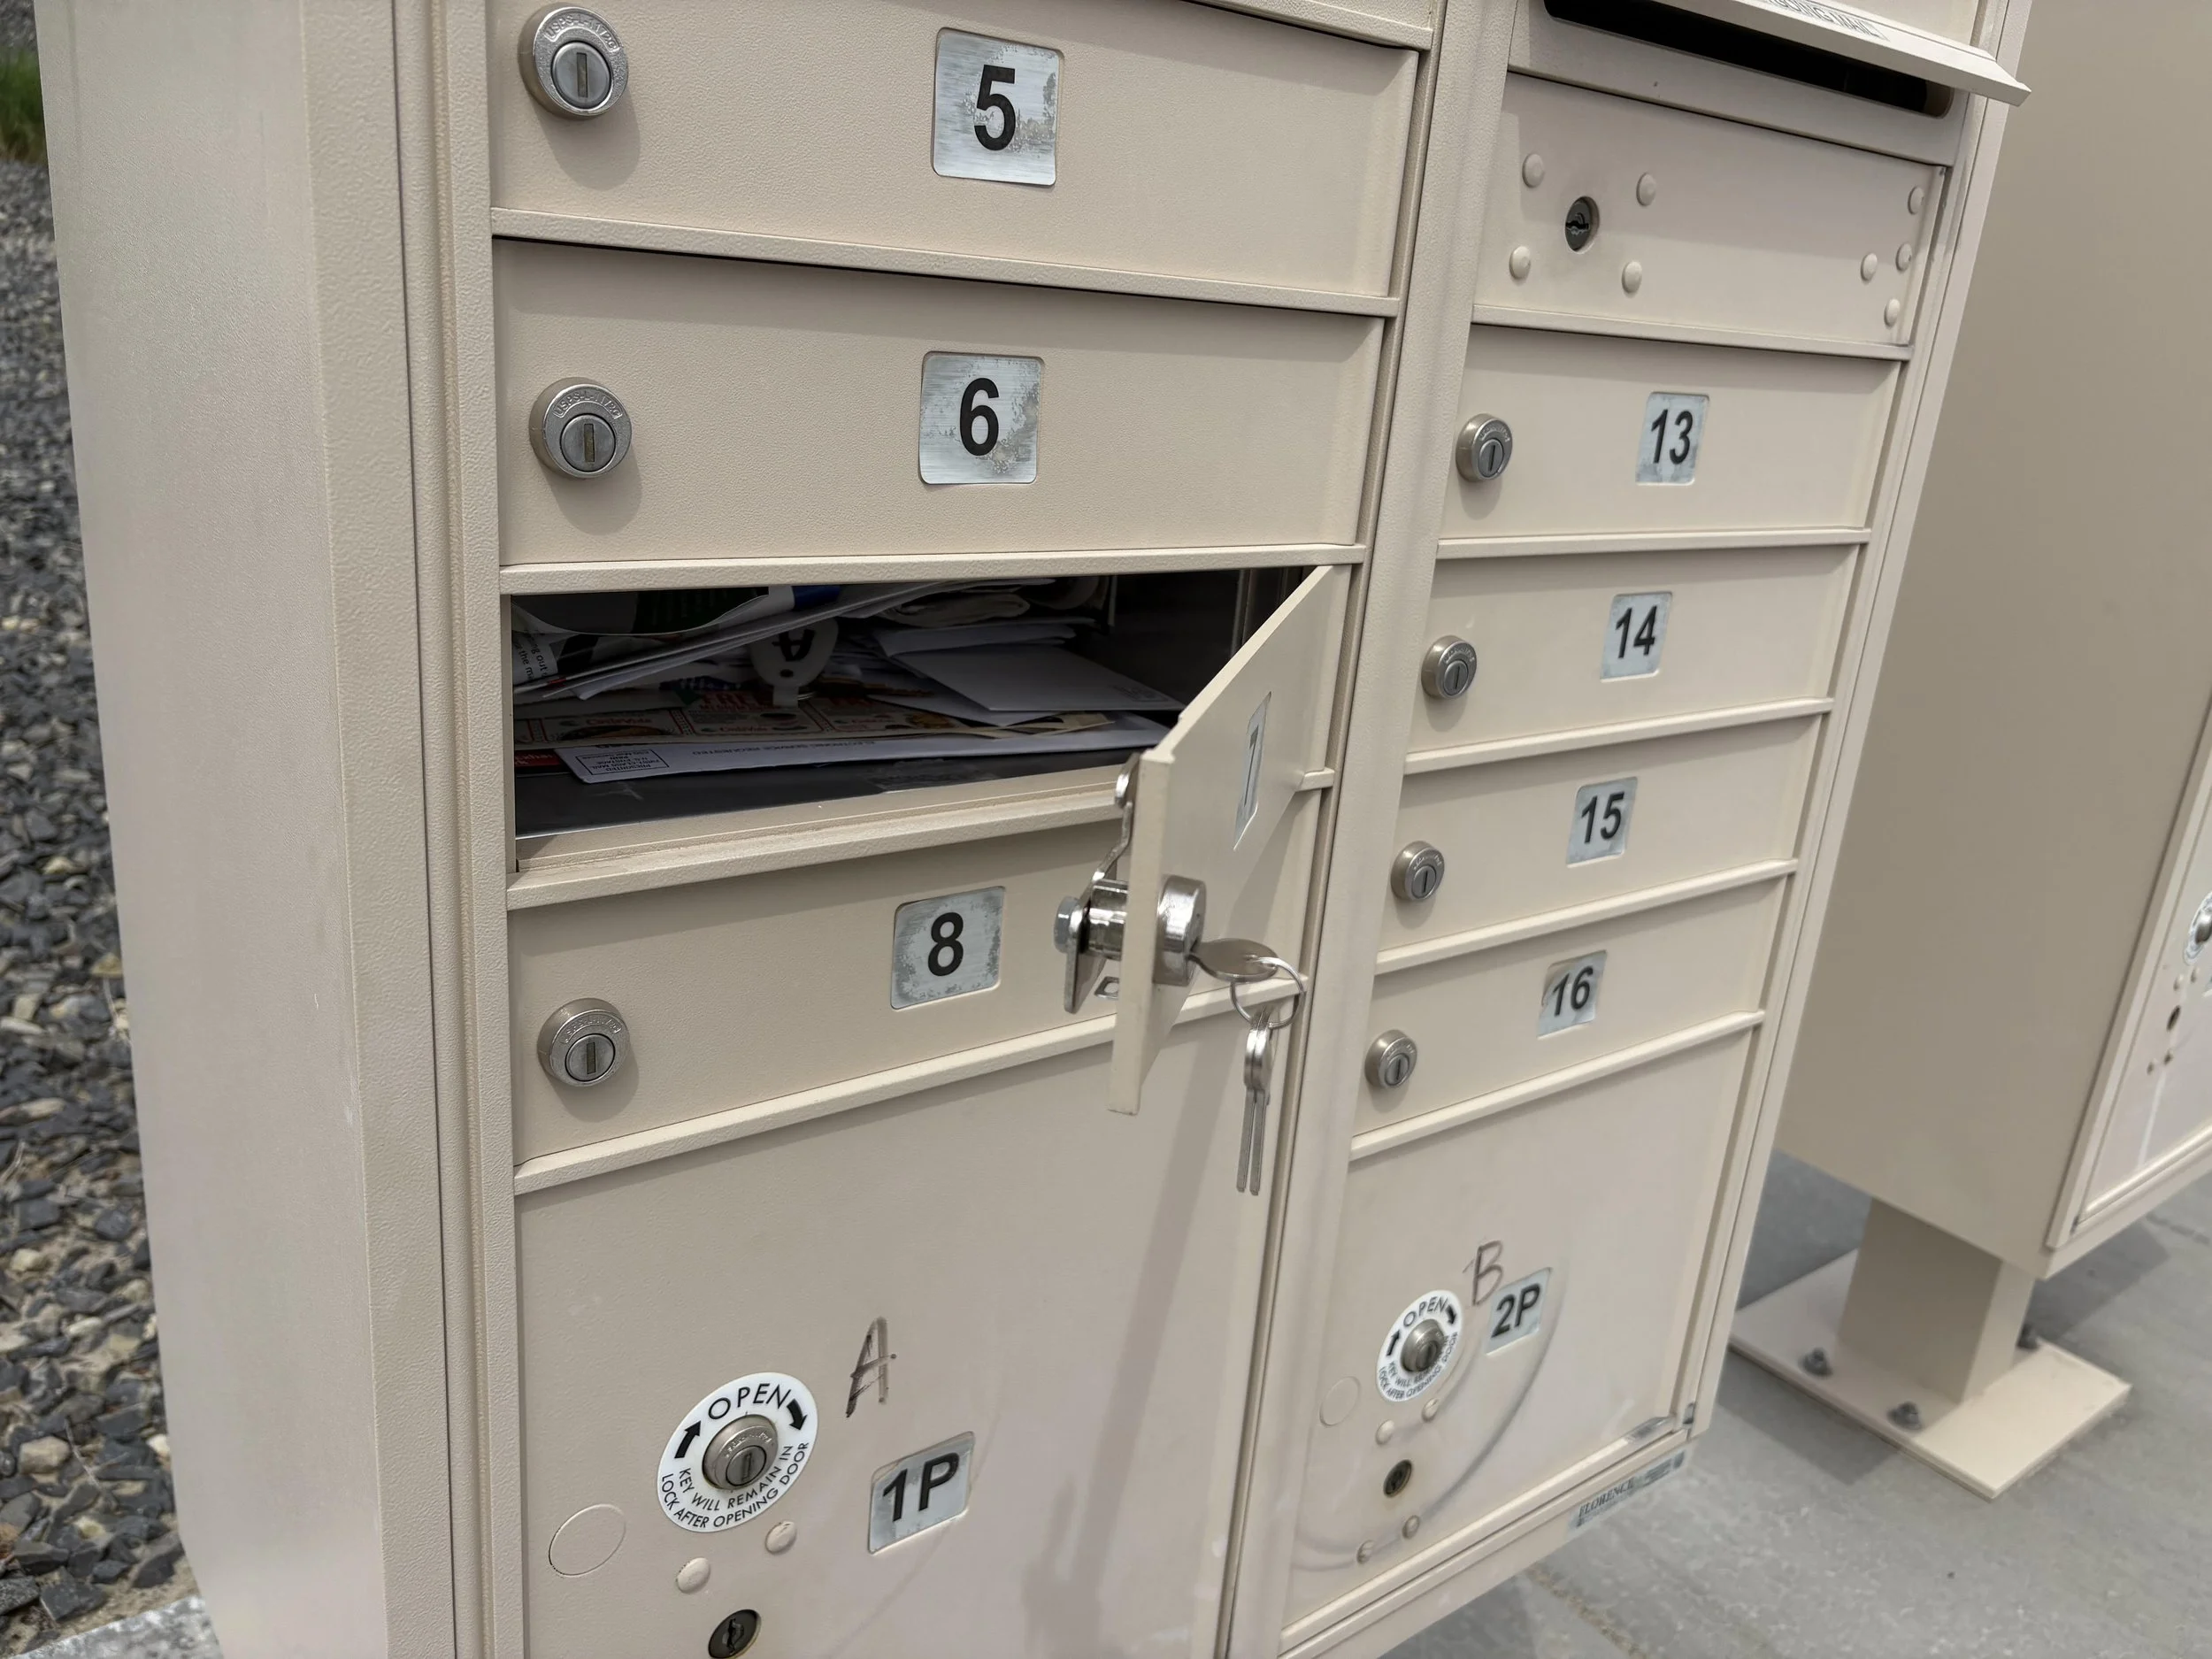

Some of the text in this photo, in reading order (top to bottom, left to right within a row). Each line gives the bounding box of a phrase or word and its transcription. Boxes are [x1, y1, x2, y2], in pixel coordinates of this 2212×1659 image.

[1828, 12, 1879, 37] MAIL
[973, 65, 1017, 151] 5
[958, 377, 1000, 456] 6
[1650, 408, 1694, 465] 13
[1615, 605, 1659, 659] 14
[1249, 725, 1259, 808] 7
[1580, 791, 1625, 844] 15
[928, 912, 964, 976] 8
[1552, 965, 1594, 1017] 16
[1471, 1240, 1503, 1306] B
[1403, 1296, 1448, 1327] OPEN
[1491, 1283, 1540, 1338] 2P
[845, 1317, 897, 1418] A
[708, 1383, 791, 1419] OPEN
[661, 1473, 680, 1510] LOCK
[673, 1508, 710, 1528] AFTER
[713, 1487, 779, 1528] OPENING
[780, 1442, 809, 1486] DOOR
[680, 1446, 794, 1510] KEY WILL REMAIN IN
[881, 1452, 961, 1523] 1P
